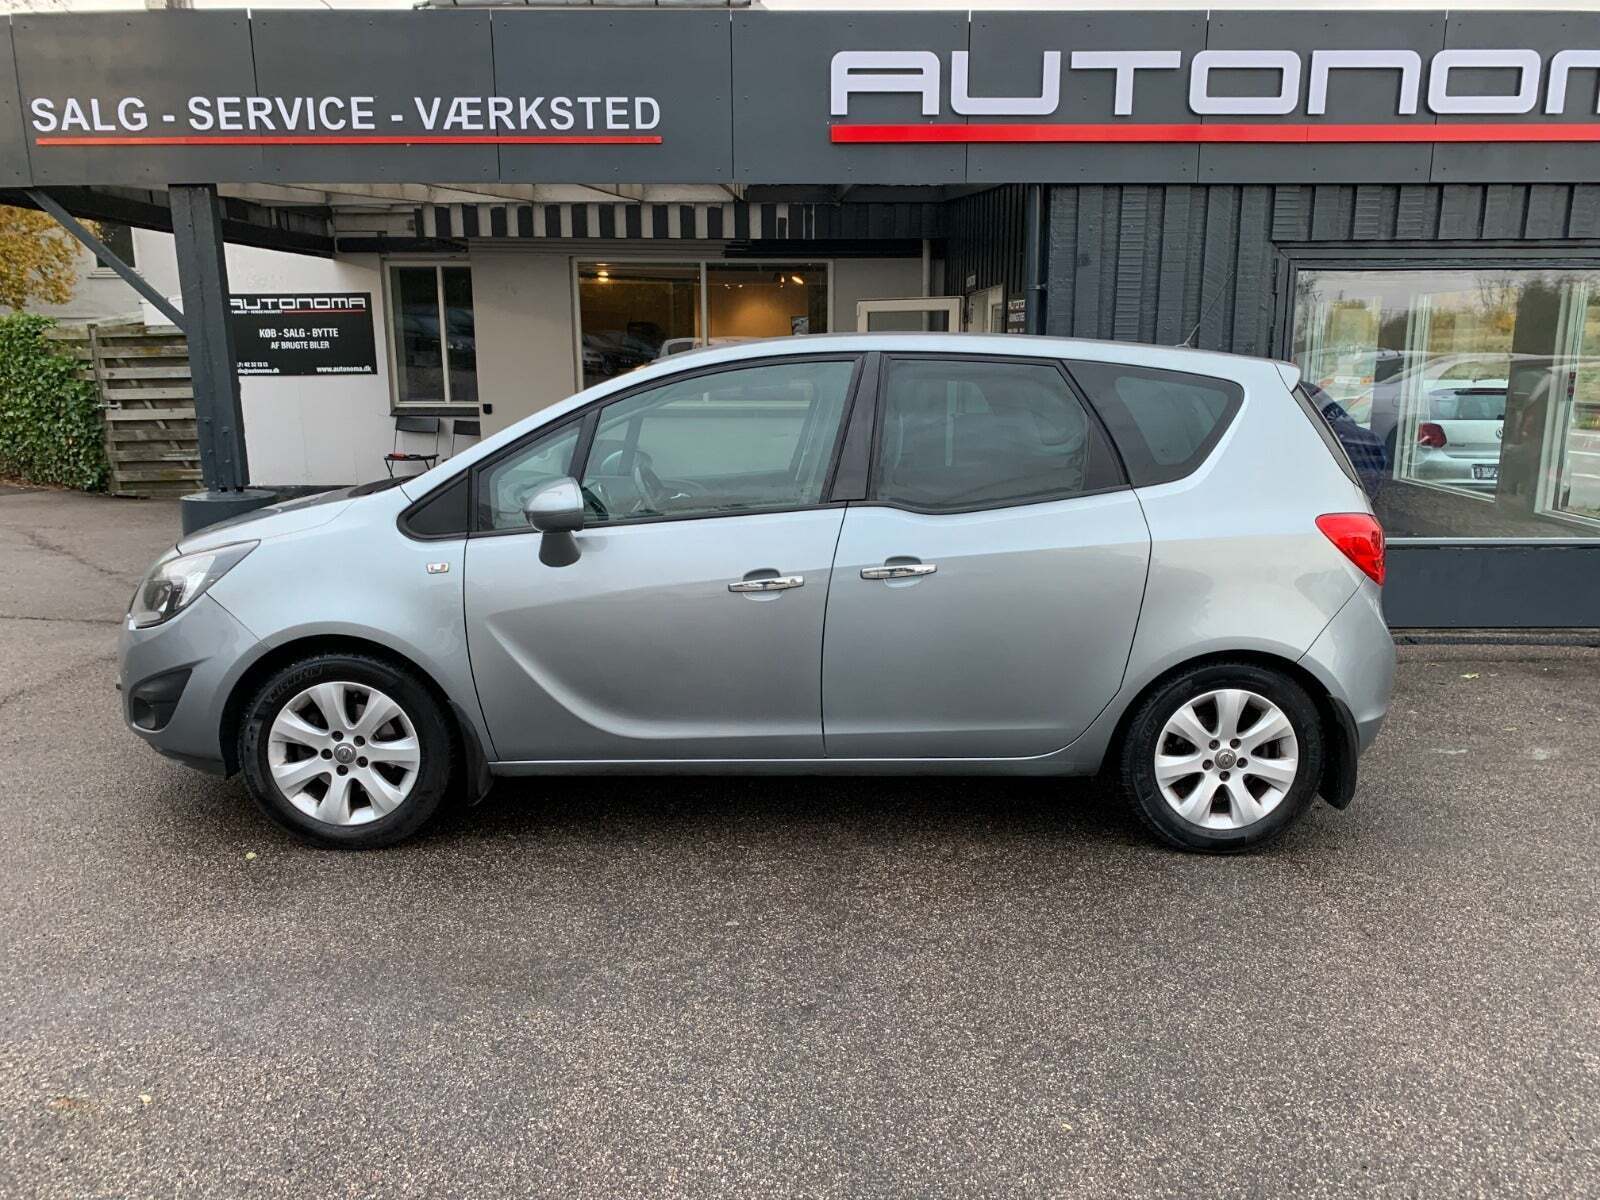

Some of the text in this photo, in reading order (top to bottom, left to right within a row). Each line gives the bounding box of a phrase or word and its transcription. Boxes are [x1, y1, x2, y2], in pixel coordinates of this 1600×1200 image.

[30, 96, 148, 132] SALG
[188, 95, 377, 131] SERVICE
[413, 95, 662, 131] VÆRKSTED
[230, 298, 366, 309] AUTONOMA
[259, 327, 277, 338] KØB
[283, 327, 306, 338] SALG
[312, 327, 339, 338] BYTTE
[270, 340, 330, 350] AF BRUGTE BILER
